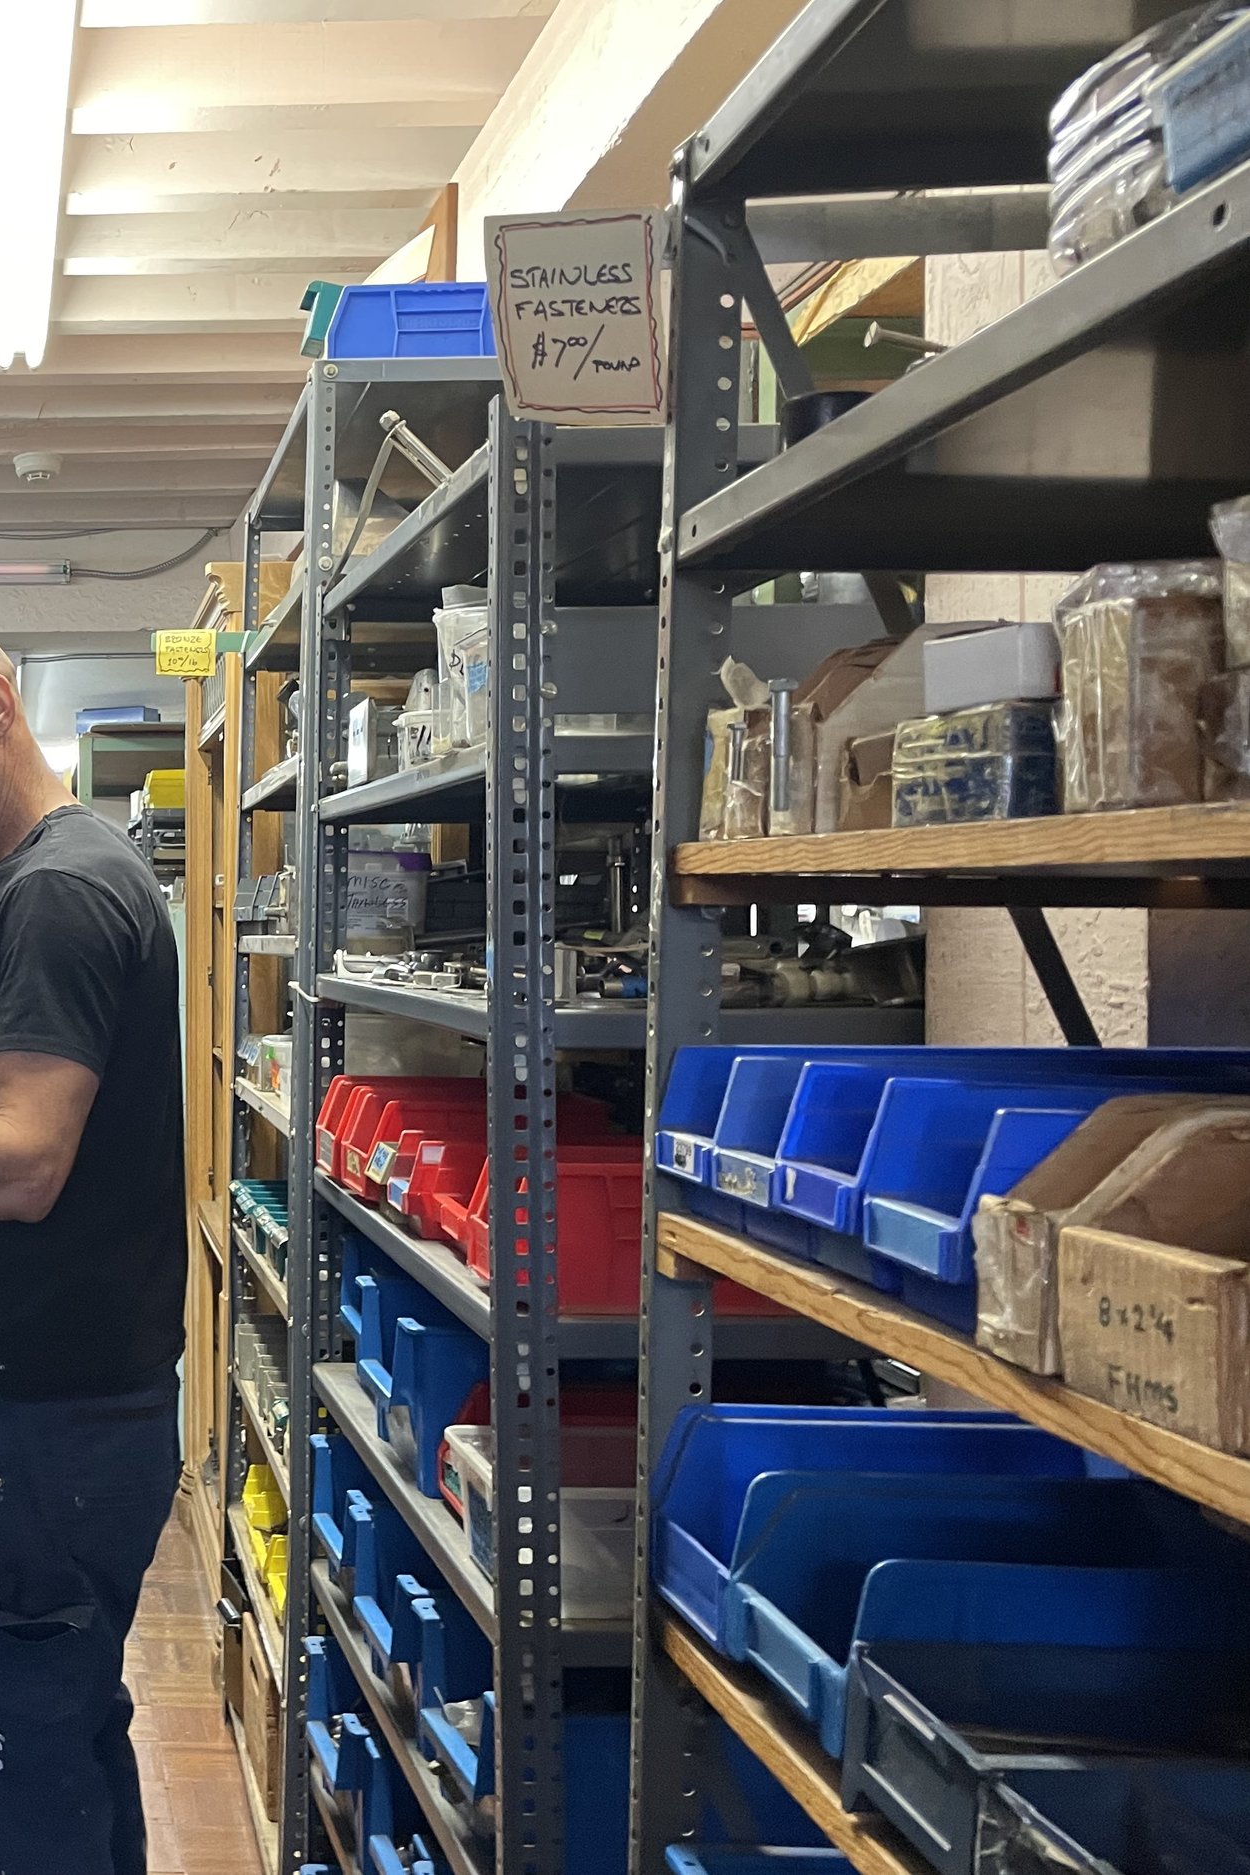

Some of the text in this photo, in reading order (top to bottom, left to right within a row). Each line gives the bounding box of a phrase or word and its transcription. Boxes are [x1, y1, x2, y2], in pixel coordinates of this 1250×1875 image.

[510, 263, 633, 289] STAINLESS
[515, 296, 642, 322] FASTENERS
[348, 876, 390, 889] MISC
